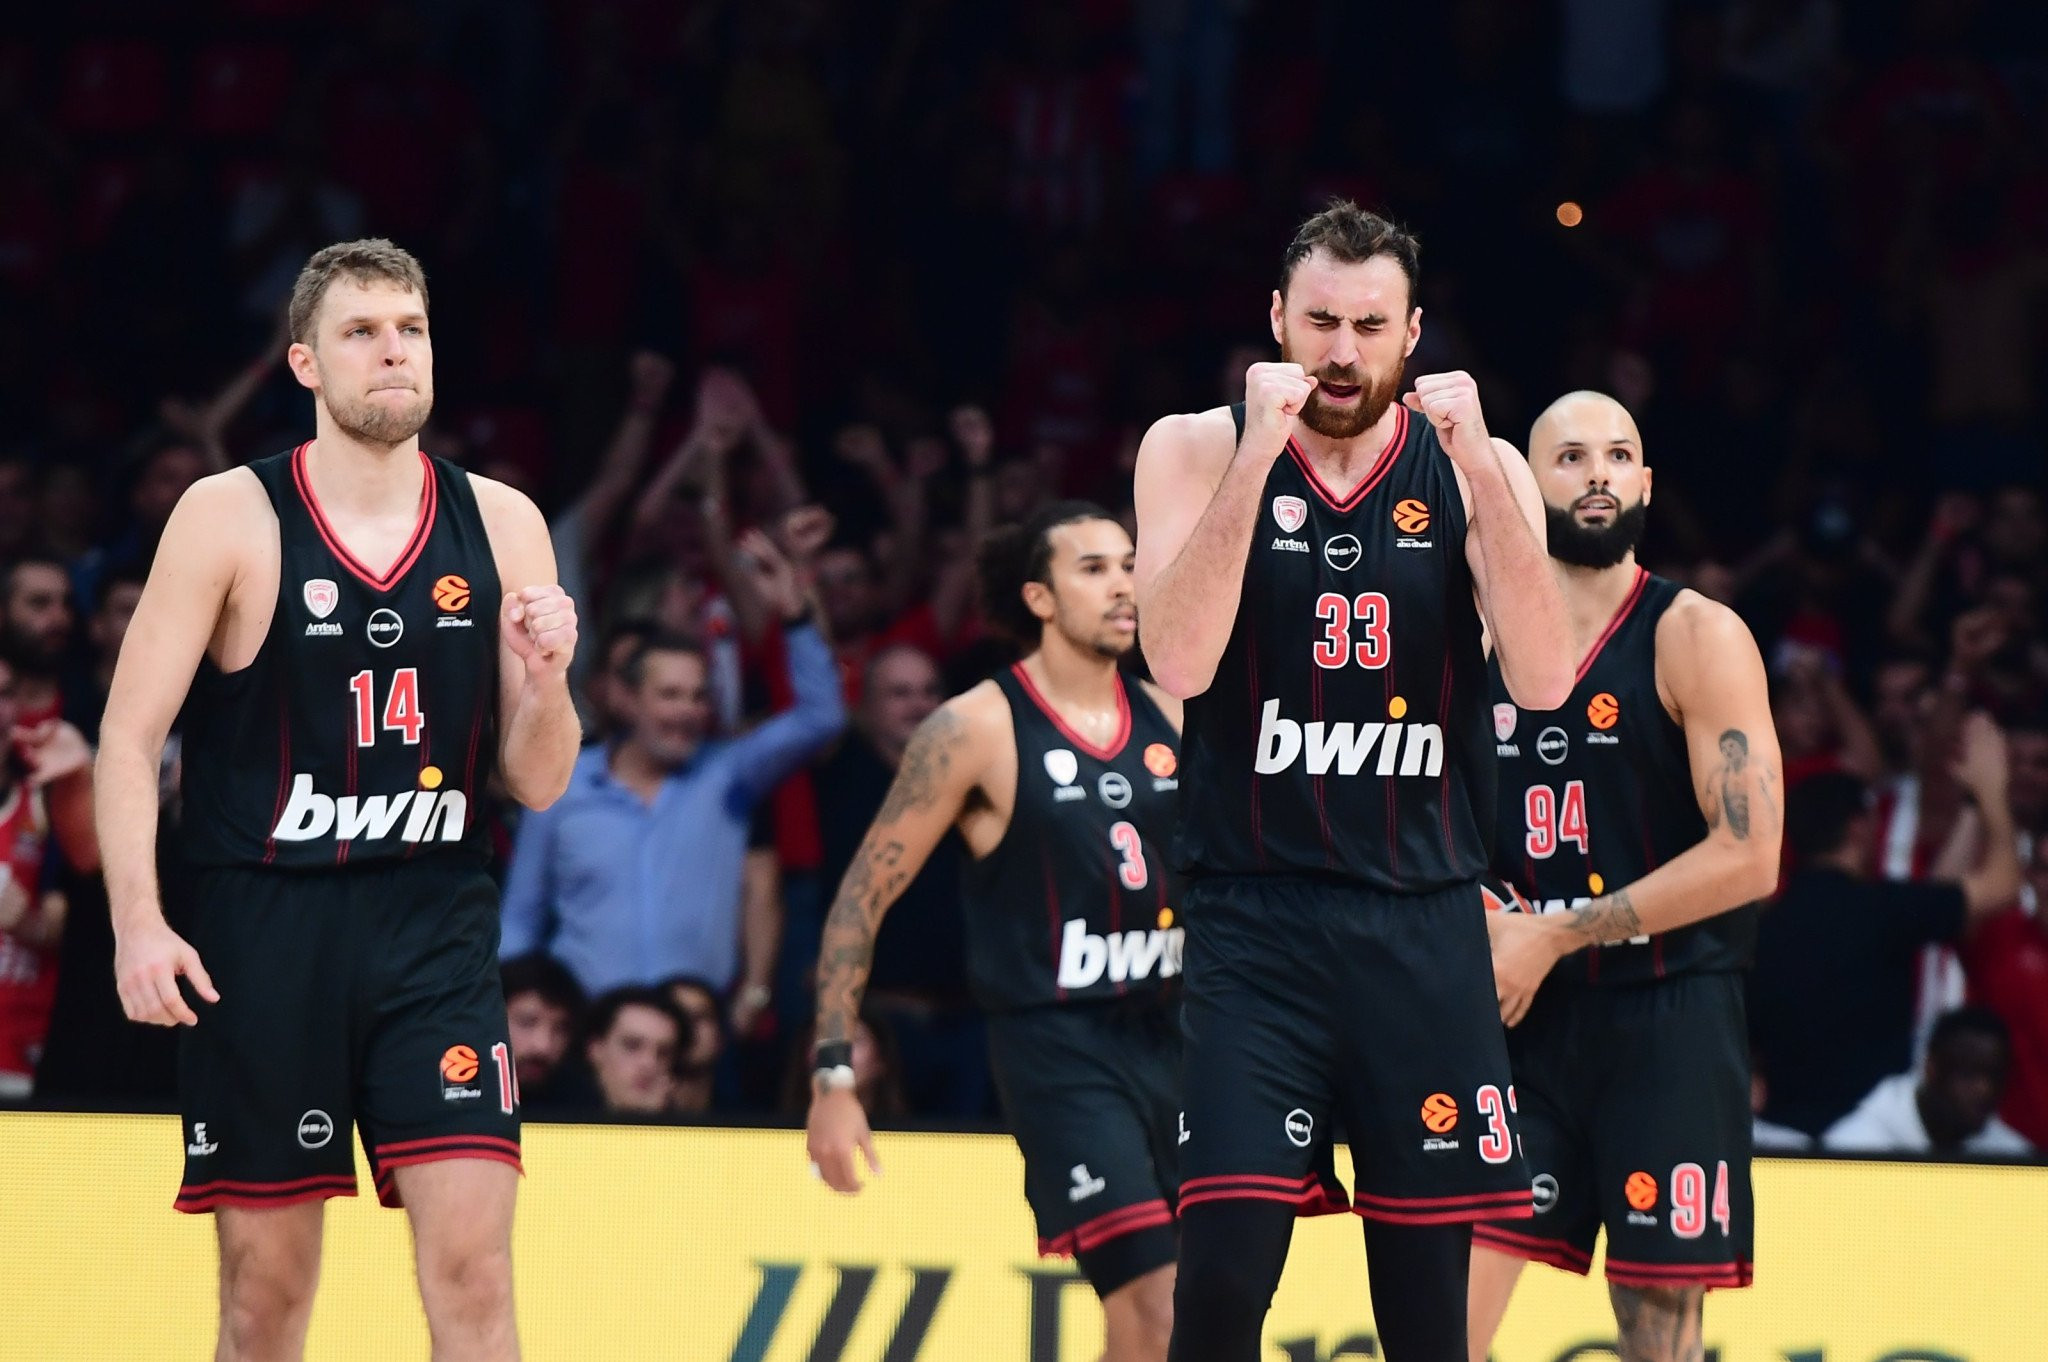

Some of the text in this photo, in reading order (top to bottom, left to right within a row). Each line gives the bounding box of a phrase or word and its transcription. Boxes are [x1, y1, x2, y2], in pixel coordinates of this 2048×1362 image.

[1313, 592, 1391, 670] 33
[350, 667, 425, 747] 14
[1254, 696, 1444, 777] bwin
[272, 766, 467, 842] bwin
[1525, 780, 1588, 859] 94
[1109, 821, 1148, 891] 3
[491, 1041, 520, 1115] 1
[1476, 1084, 1523, 1164] 3
[1670, 1160, 1730, 1239] 94
